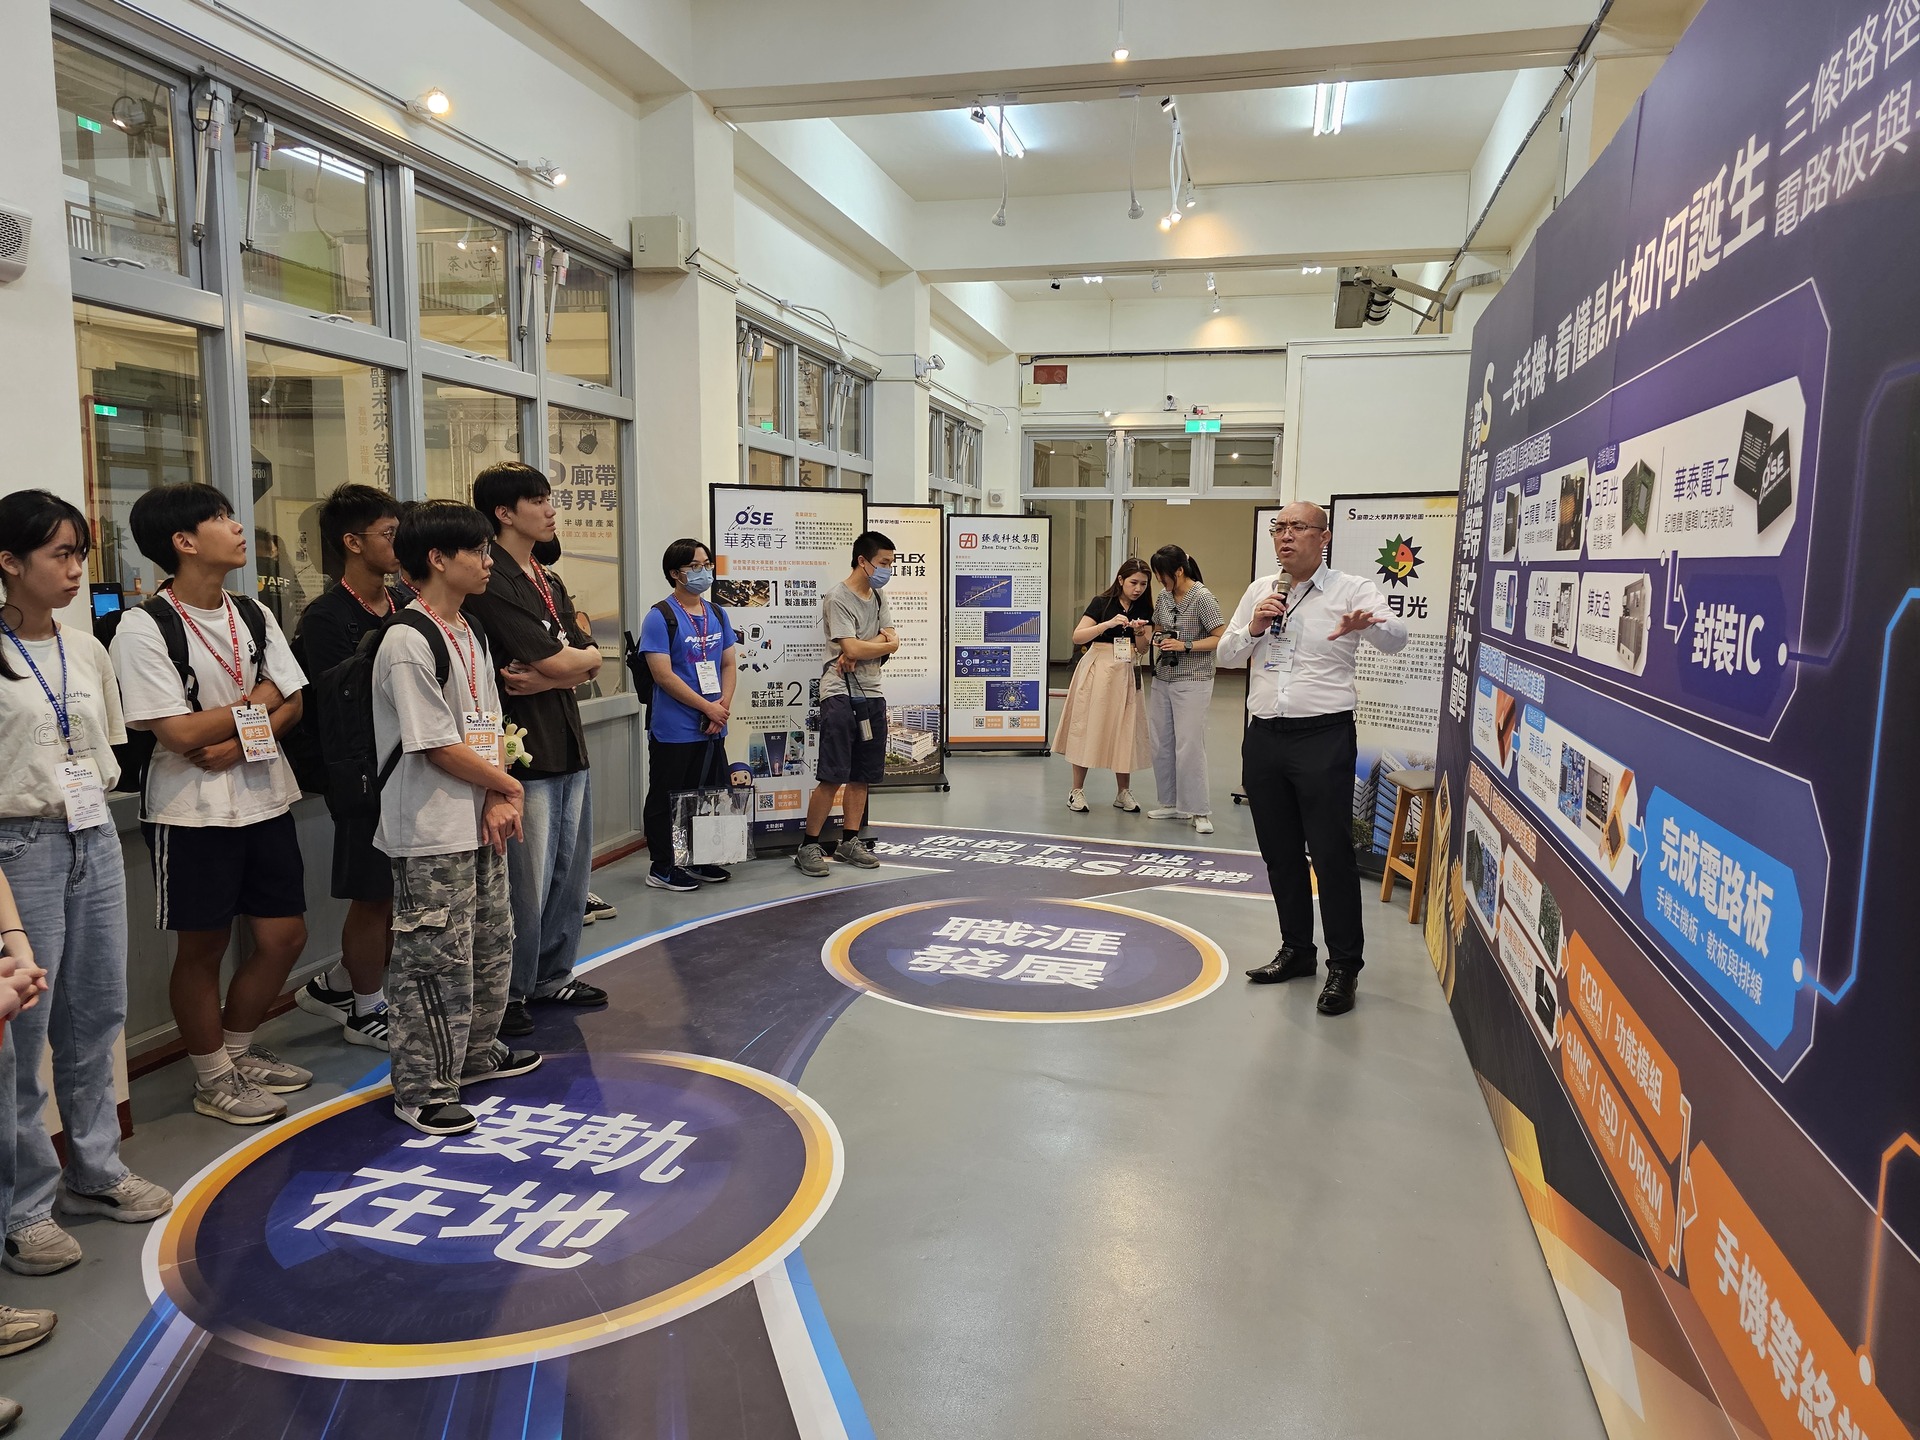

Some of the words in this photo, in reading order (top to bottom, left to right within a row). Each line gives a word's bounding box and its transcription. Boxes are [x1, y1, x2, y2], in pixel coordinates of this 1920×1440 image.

[1780, 0, 1920, 156] 三條路徑
[1774, 79, 1920, 238] 電路板與
[1503, 134, 1770, 416] 一支手機，看懂晶片如何誕生
[370, 368, 391, 494] 體未來，等你
[1594, 474, 1619, 508] 日月光
[1672, 454, 1730, 502] 華泰電子
[1762, 450, 1784, 489] OSE
[735, 511, 774, 526] OSE
[724, 533, 788, 549] 華泰電子
[771, 580, 778, 606] 1
[784, 580, 817, 589] 積體電路
[784, 598, 817, 607] 製造服務
[1534, 576, 1550, 596] ASML
[1690, 600, 1765, 682] 封裝IC
[751, 691, 784, 699] 電子代工
[751, 699, 784, 708] 製造服務
[787, 681, 803, 707] 2
[872, 841, 1254, 884] 就在高雄S廊帶
[920, 834, 1216, 866] 你的下一站，
[1658, 810, 1774, 962] 完成電路板
[932, 916, 1127, 956] 職涯
[1655, 883, 1763, 1009] 手機主機板、軟板與排線
[908, 944, 1107, 990] 發展
[1579, 961, 1604, 1024] PCBA
[1613, 1008, 1664, 1118] 功能模組
[401, 1096, 698, 1184] 接軌
[1565, 1022, 1592, 1093] e.MMC
[1598, 1080, 1618, 1142] SSD
[1627, 1130, 1664, 1224] DRAM
[293, 1165, 631, 1270] 在地
